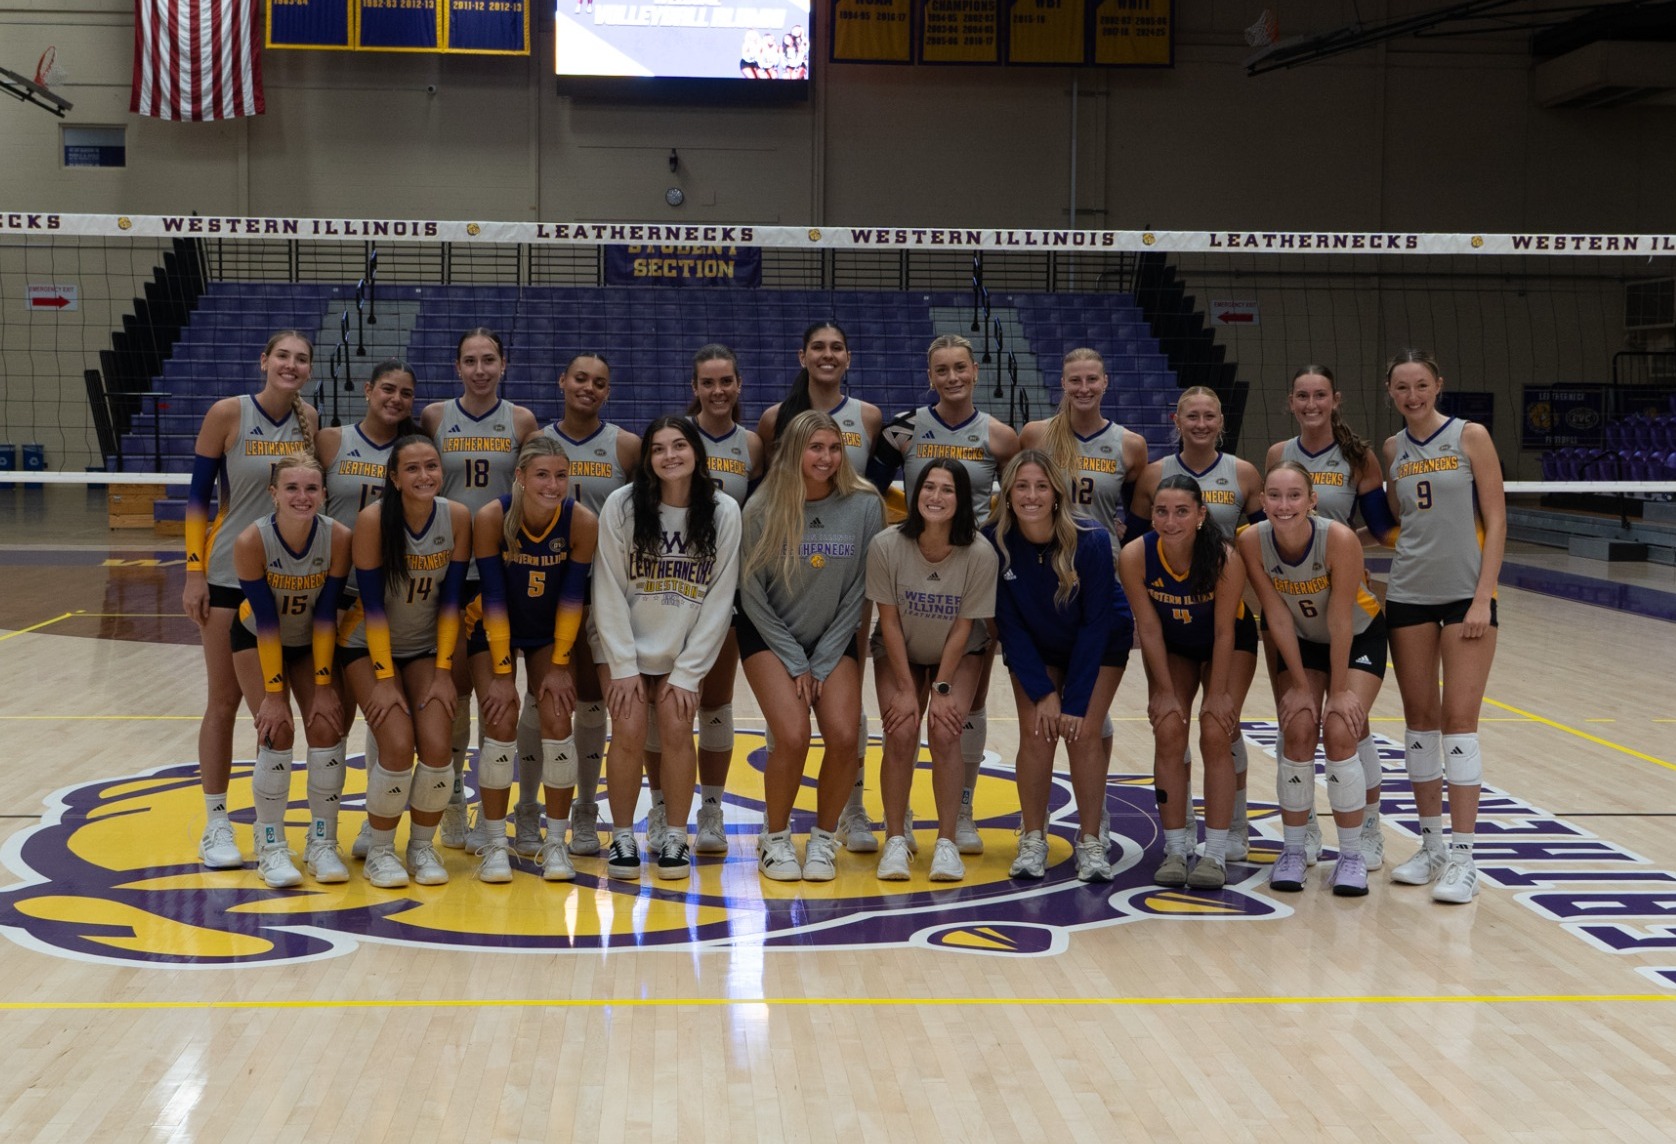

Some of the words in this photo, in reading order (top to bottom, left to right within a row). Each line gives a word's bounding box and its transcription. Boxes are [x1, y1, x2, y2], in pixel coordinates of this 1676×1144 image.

[452, 1, 485, 11] 2011-12
[489, 3, 522, 12] 2012-13
[931, 0, 996, 11] CHAMPIONS
[0, 214, 61, 230] CKS
[163, 216, 300, 234] WESTERN
[313, 217, 441, 237] ILLINOIS
[537, 222, 754, 242] LEATHERNECKS
[852, 226, 983, 245] WESTERN
[994, 228, 1115, 247] ILLINOIS
[1210, 232, 1419, 250] LEATHERNECKS
[1512, 235, 1639, 251] WESTERN
[633, 259, 735, 278] SECTION
[443, 436, 512, 453] LEATHERNECKS
[916, 443, 985, 461] LEATHERNECKS
[338, 459, 387, 480] LEATHER
[464, 458, 490, 488] 18
[1072, 477, 1094, 505] 12
[1417, 480, 1432, 510] 9
[406, 577, 433, 604] 14
[527, 570, 546, 598] 5
[643, 579, 699, 600] WESTERN
[281, 594, 309, 616] 15
[1298, 599, 1318, 618] 6
[1172, 608, 1193, 625] 4
